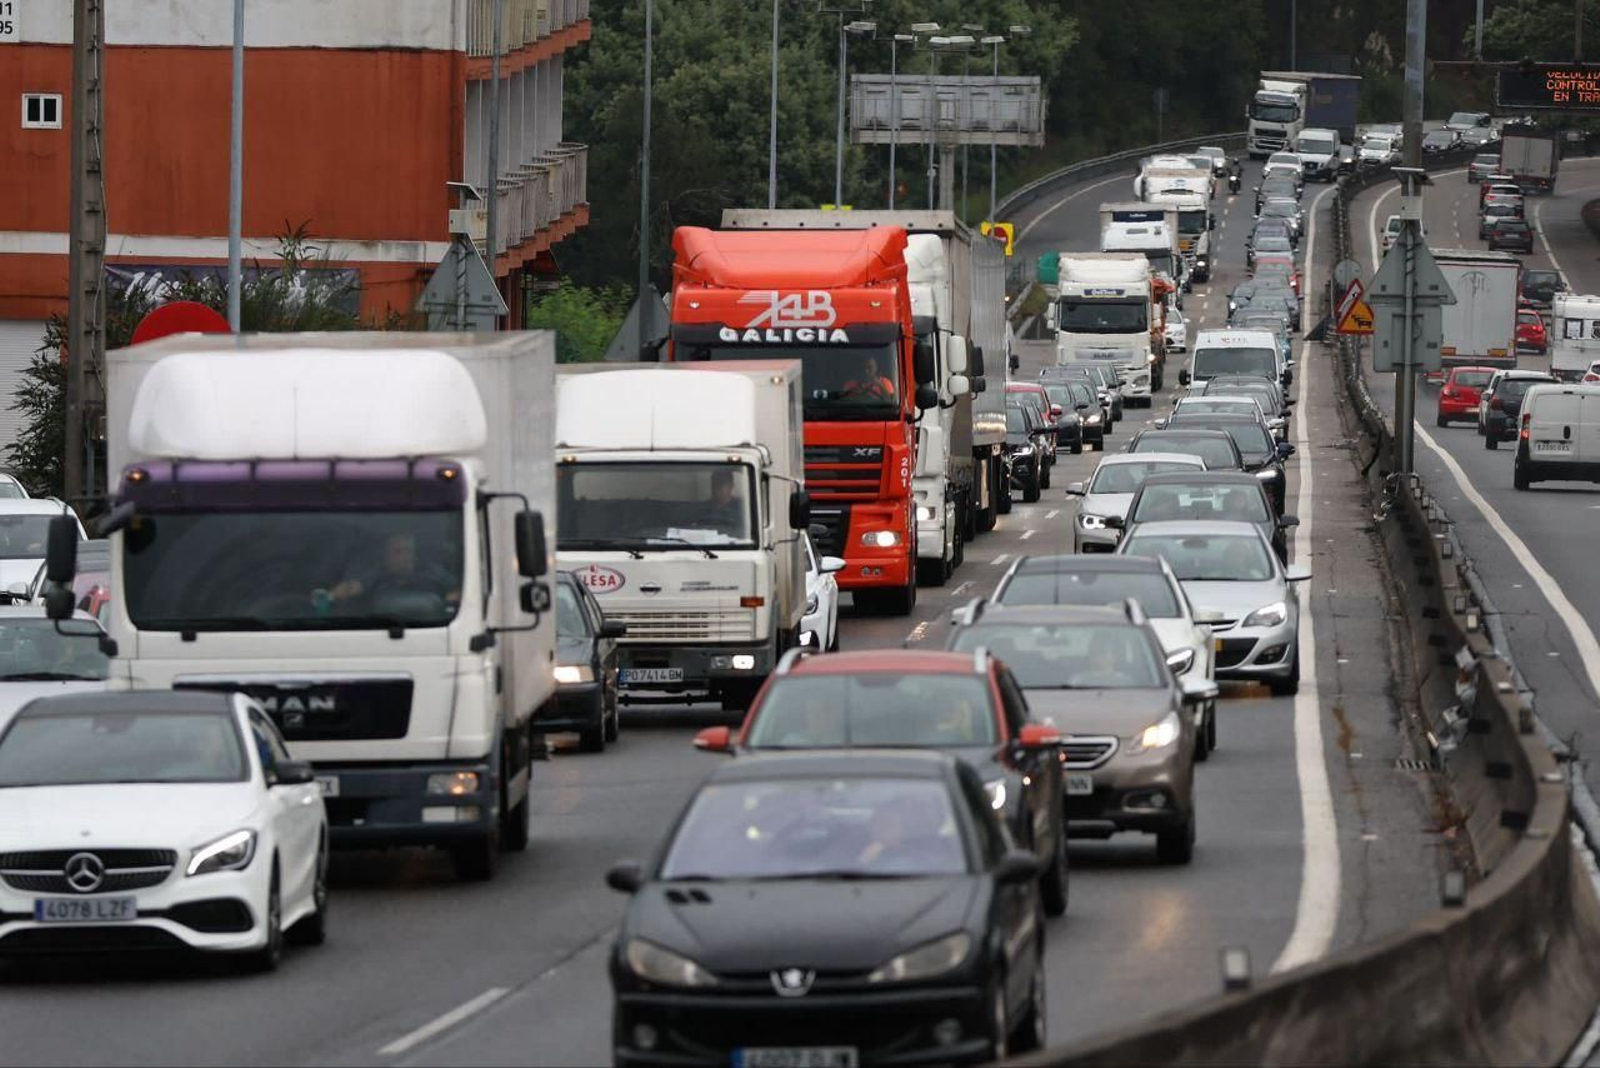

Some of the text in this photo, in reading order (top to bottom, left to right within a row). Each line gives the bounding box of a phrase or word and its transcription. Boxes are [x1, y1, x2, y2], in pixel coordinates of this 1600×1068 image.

[1546, 80, 1600, 91] CONTROL
[1554, 91, 1570, 102] EN
[719, 326, 850, 342] GALICIA
[852, 448, 881, 457] XF
[579, 574, 617, 587] LESA
[46, 900, 130, 918] 4078 LZF
